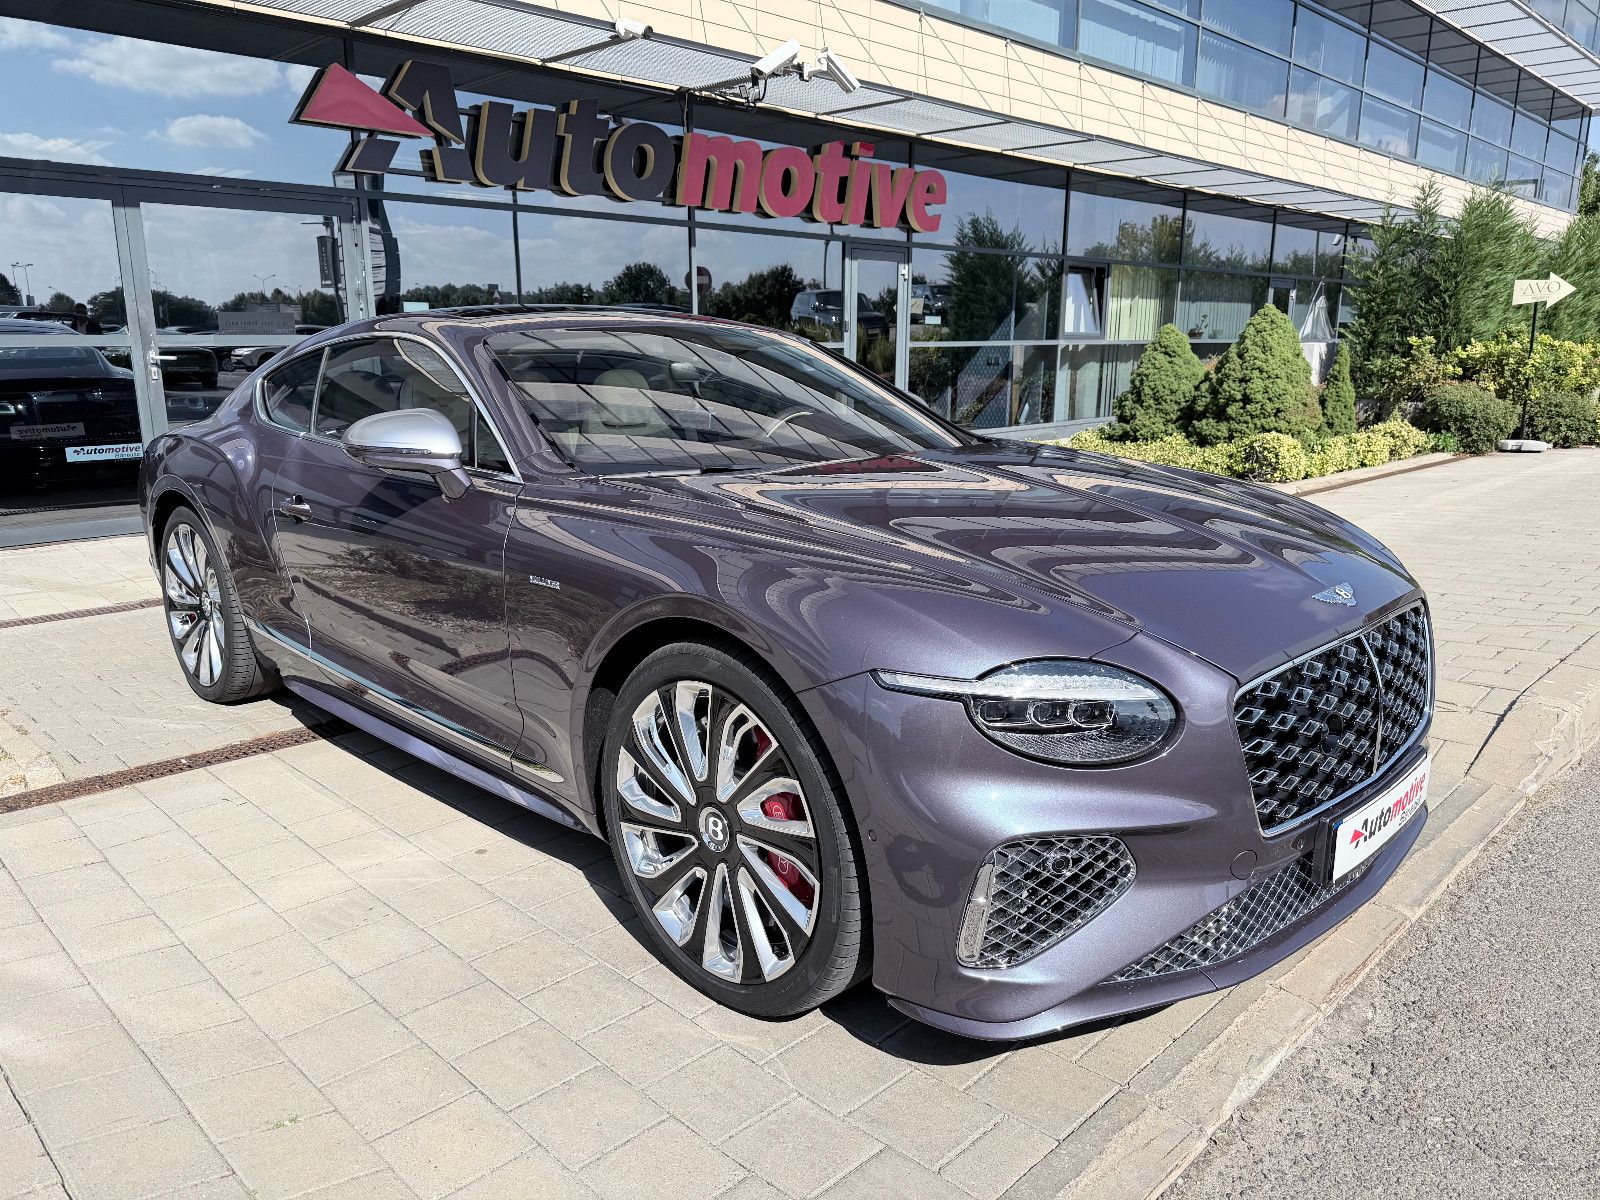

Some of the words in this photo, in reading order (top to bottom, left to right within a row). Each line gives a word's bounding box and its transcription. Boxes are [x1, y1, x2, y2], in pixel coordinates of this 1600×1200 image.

[291, 58, 948, 233] Automotive
[1523, 281, 1561, 295] AVO
[73, 445, 140, 456] Automotive
[1350, 773, 1426, 849] Automotive
[709, 817, 724, 841] B
